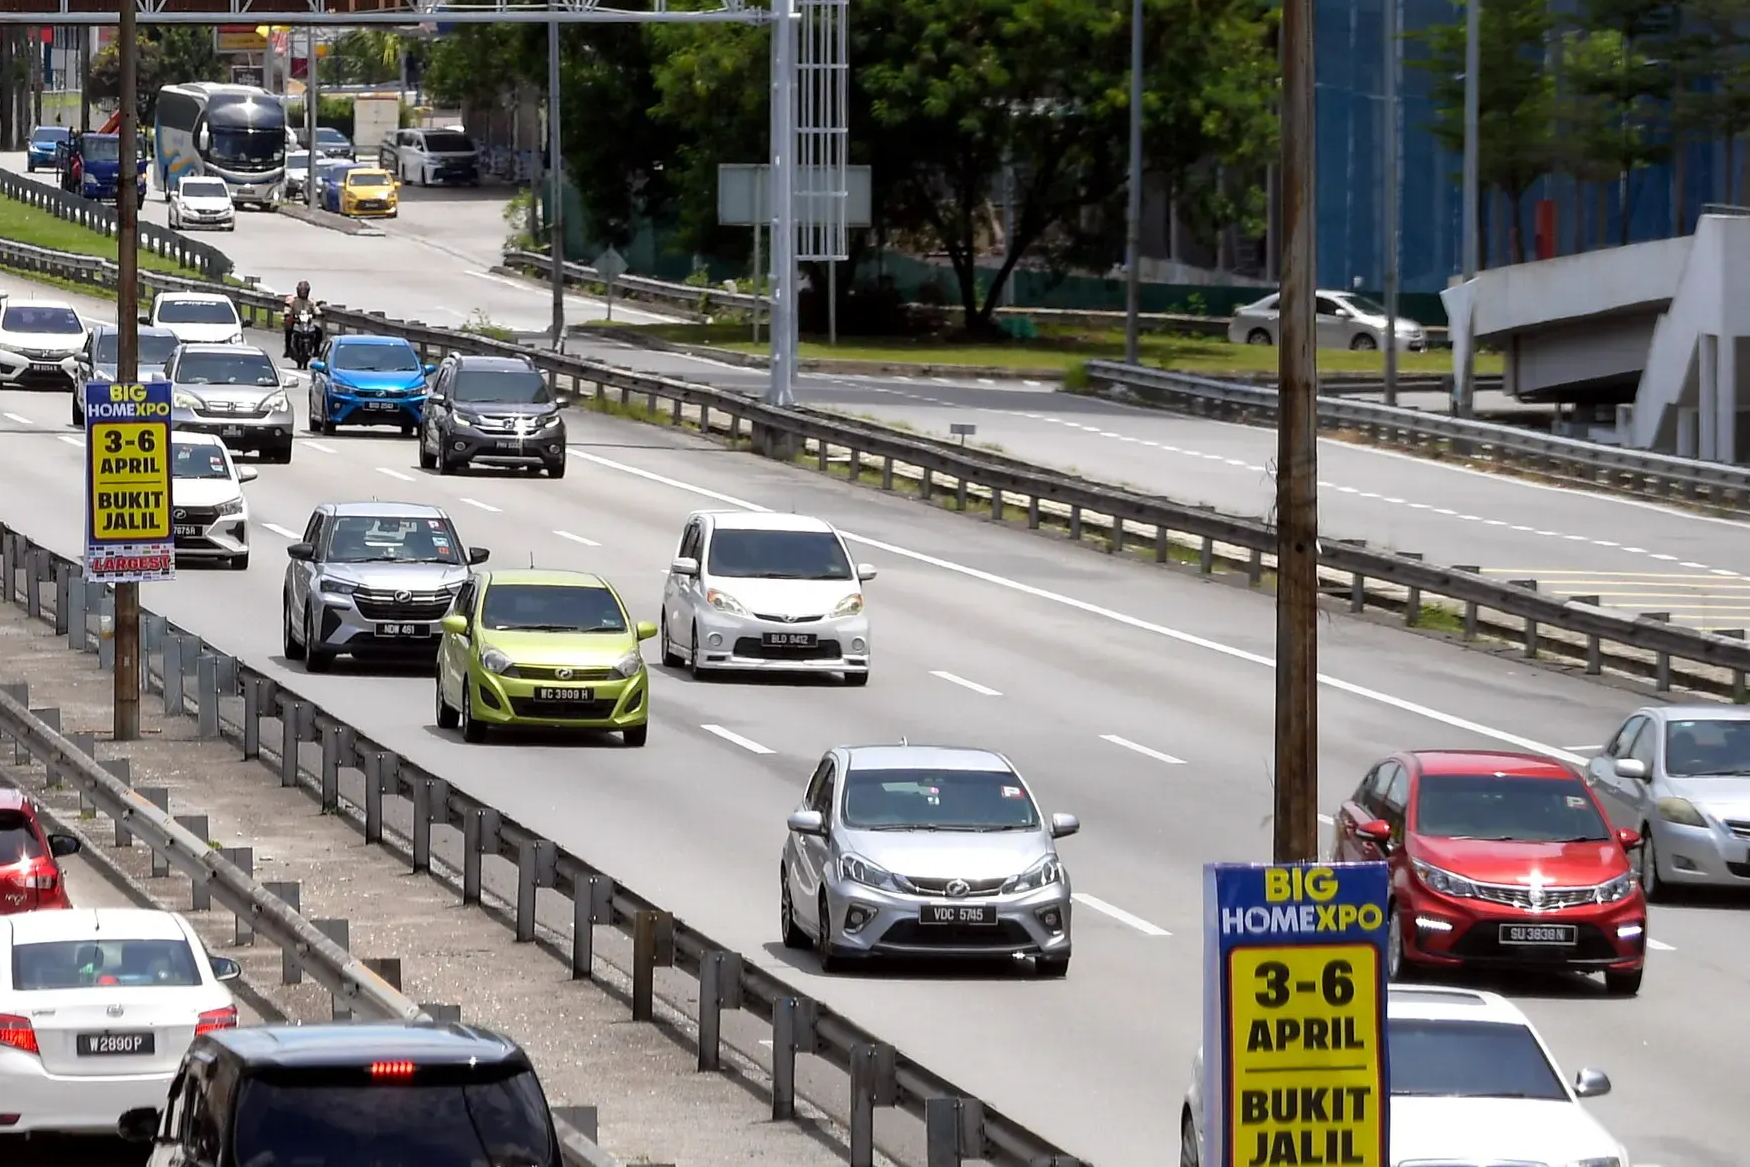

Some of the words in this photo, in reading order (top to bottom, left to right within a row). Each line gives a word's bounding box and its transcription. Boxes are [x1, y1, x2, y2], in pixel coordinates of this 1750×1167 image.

[110, 384, 147, 402] BIG
[88, 402, 169, 417] HOMEXPO
[104, 429, 155, 453] 3-6
[100, 457, 160, 474] APRIL
[98, 491, 163, 510] BUKIT
[102, 511, 160, 530] JALIL
[92, 554, 171, 572] LARGEST
[384, 624, 400, 633] NDW
[402, 624, 415, 634] 461
[540, 689, 554, 699] WC
[555, 689, 579, 700] 3909
[1003, 785, 1022, 798] P
[1263, 867, 1338, 903] BIG
[934, 907, 954, 920] VDC
[959, 908, 983, 921] 5745
[1222, 903, 1383, 935] HOMEXPO
[1254, 959, 1354, 1009] 3-6
[1246, 1017, 1365, 1053] APRIL
[1241, 1086, 1371, 1127] BUKIT
[1248, 1130, 1365, 1167] JALIL
